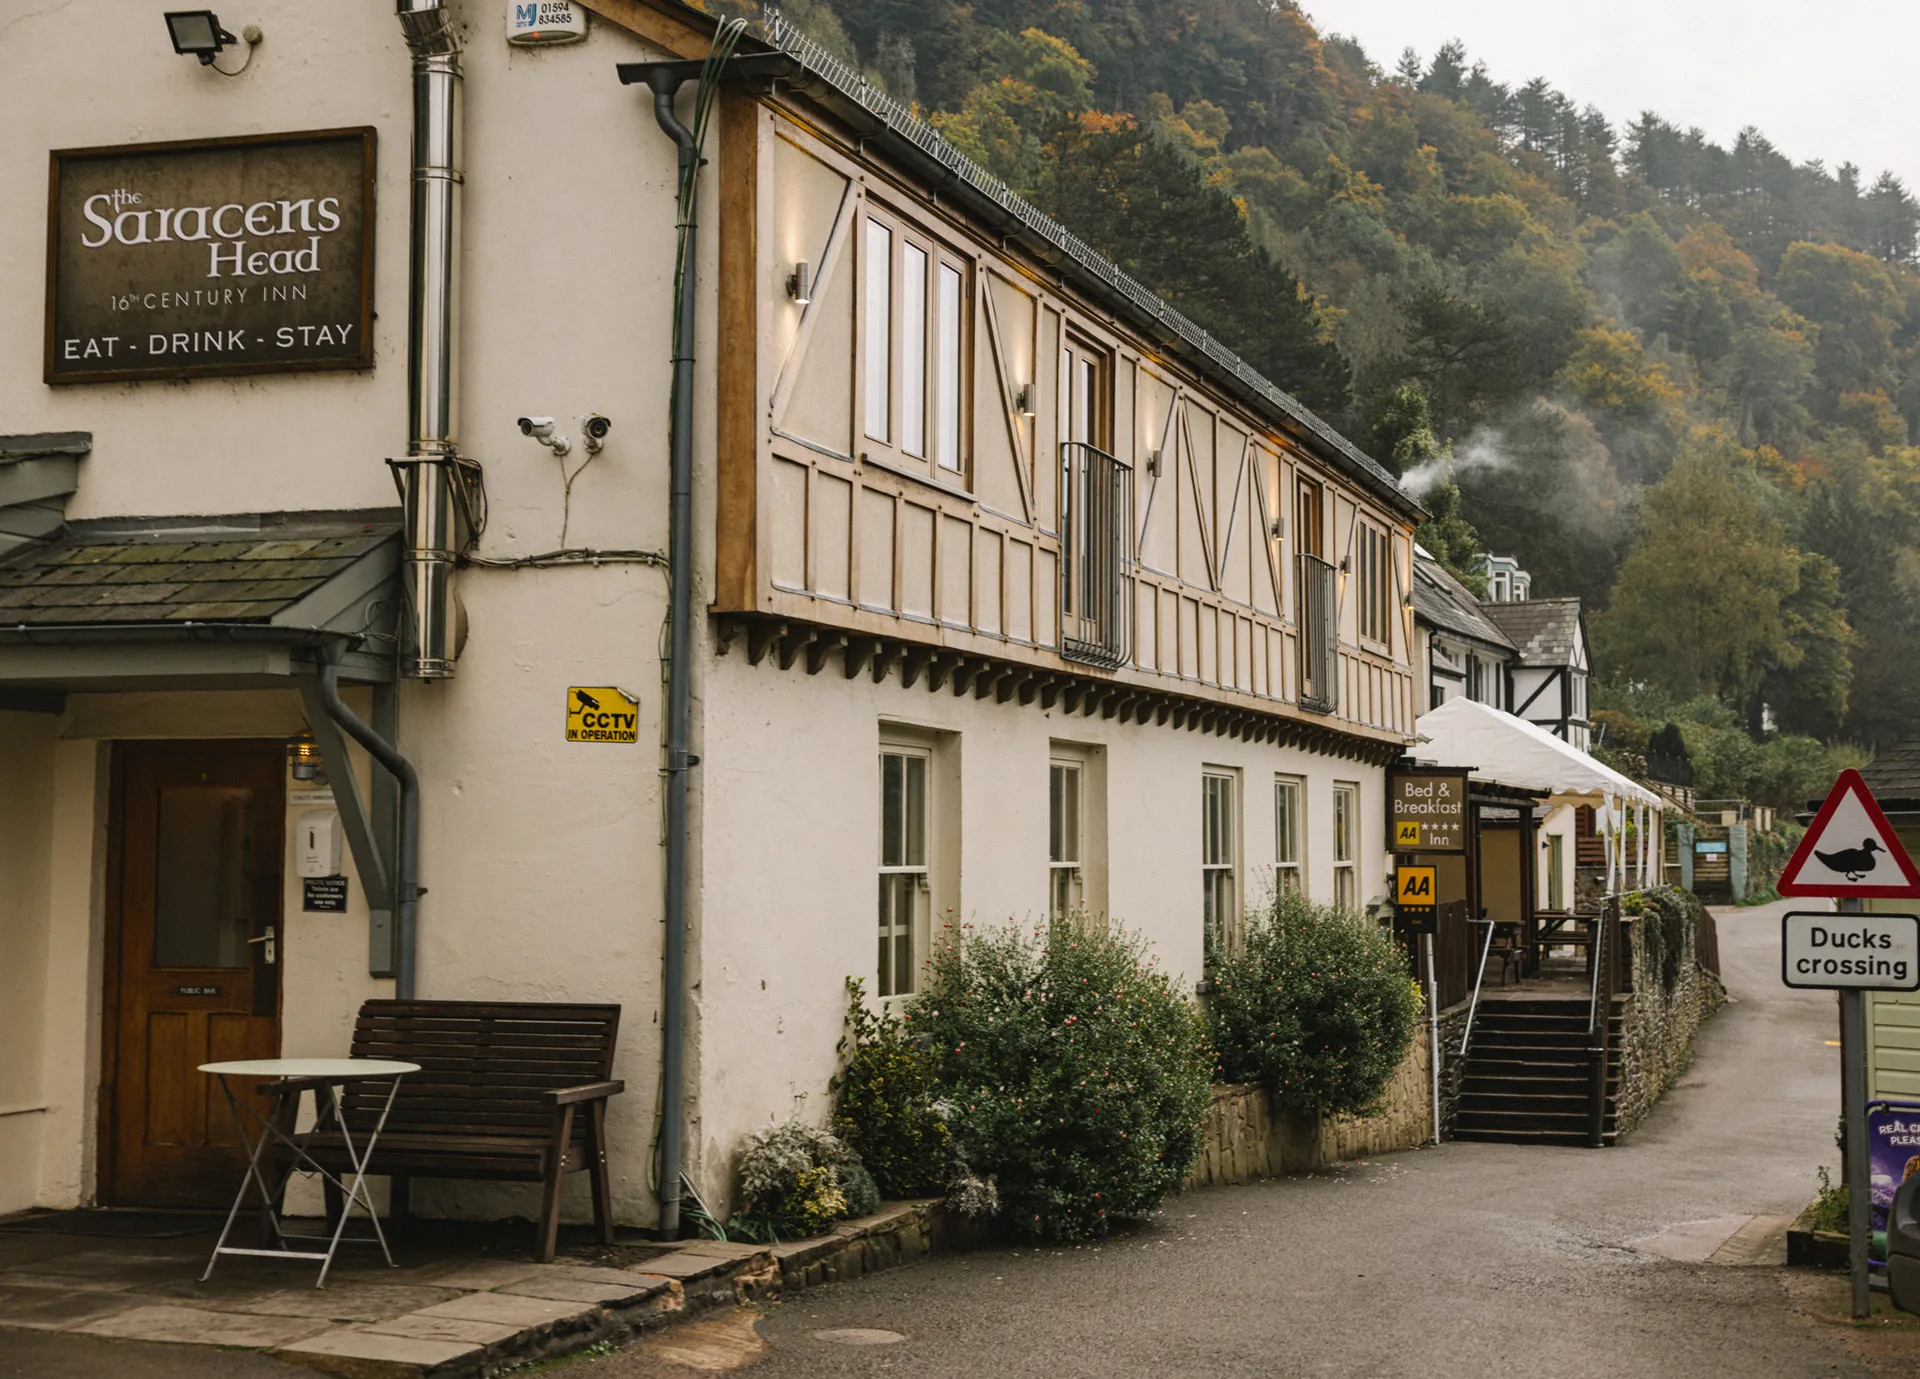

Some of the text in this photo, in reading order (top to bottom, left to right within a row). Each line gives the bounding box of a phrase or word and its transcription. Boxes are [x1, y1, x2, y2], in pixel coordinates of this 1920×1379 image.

[541, 2, 570, 14] 01594
[538, 13, 572, 25] 834585
[112, 188, 142, 213] the
[81, 194, 341, 248] Saracens
[206, 236, 321, 278] Head
[143, 287, 248, 310] CENTURY
[263, 285, 308, 302] INN
[64, 336, 119, 360] EAT
[149, 329, 246, 355] DRINK
[275, 323, 353, 348] STAY
[582, 712, 635, 729] CCTV
[568, 729, 635, 741] IN OPERATION
[1405, 782, 1450, 797] Bed &
[1394, 798, 1462, 814] Breakfast
[1400, 827, 1449, 846] AA Inn
[1403, 876, 1430, 896] AA
[1811, 927, 1892, 949] Ducks
[1796, 955, 1908, 980] crossing
[1879, 1123, 1908, 1135] REAL
